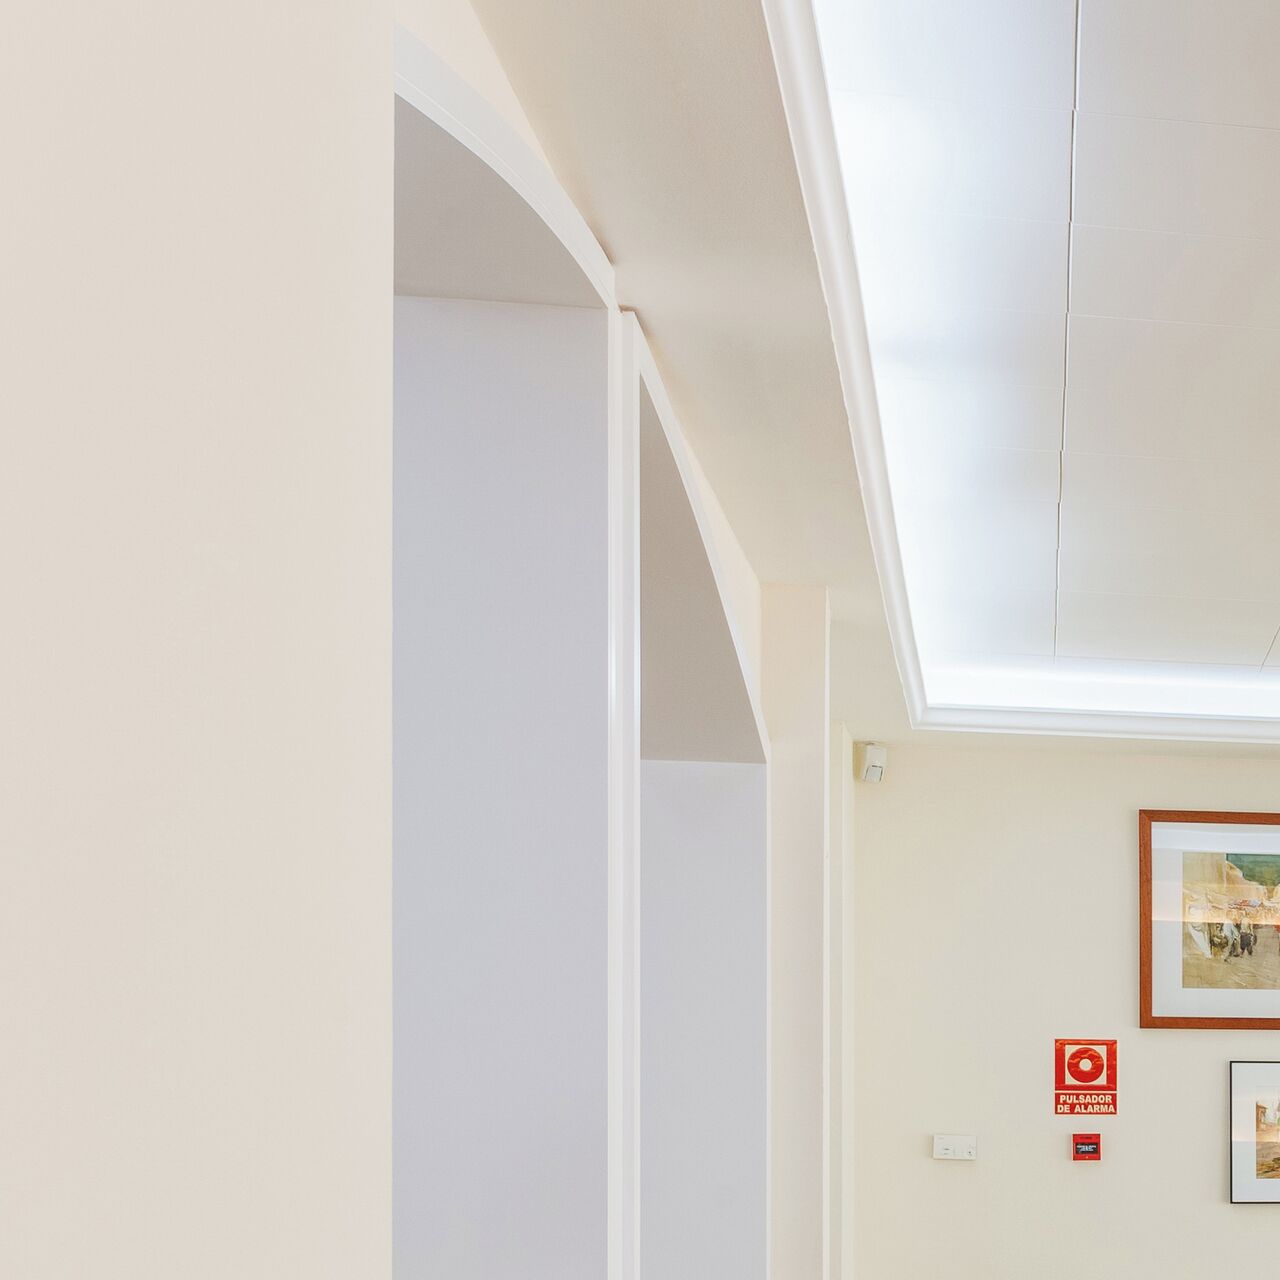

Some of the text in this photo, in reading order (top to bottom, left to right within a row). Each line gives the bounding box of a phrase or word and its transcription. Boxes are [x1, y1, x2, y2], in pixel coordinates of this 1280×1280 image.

[1060, 1094, 1112, 1104] PULSADOR
[1057, 1104, 1115, 1113] DE ALARMA
